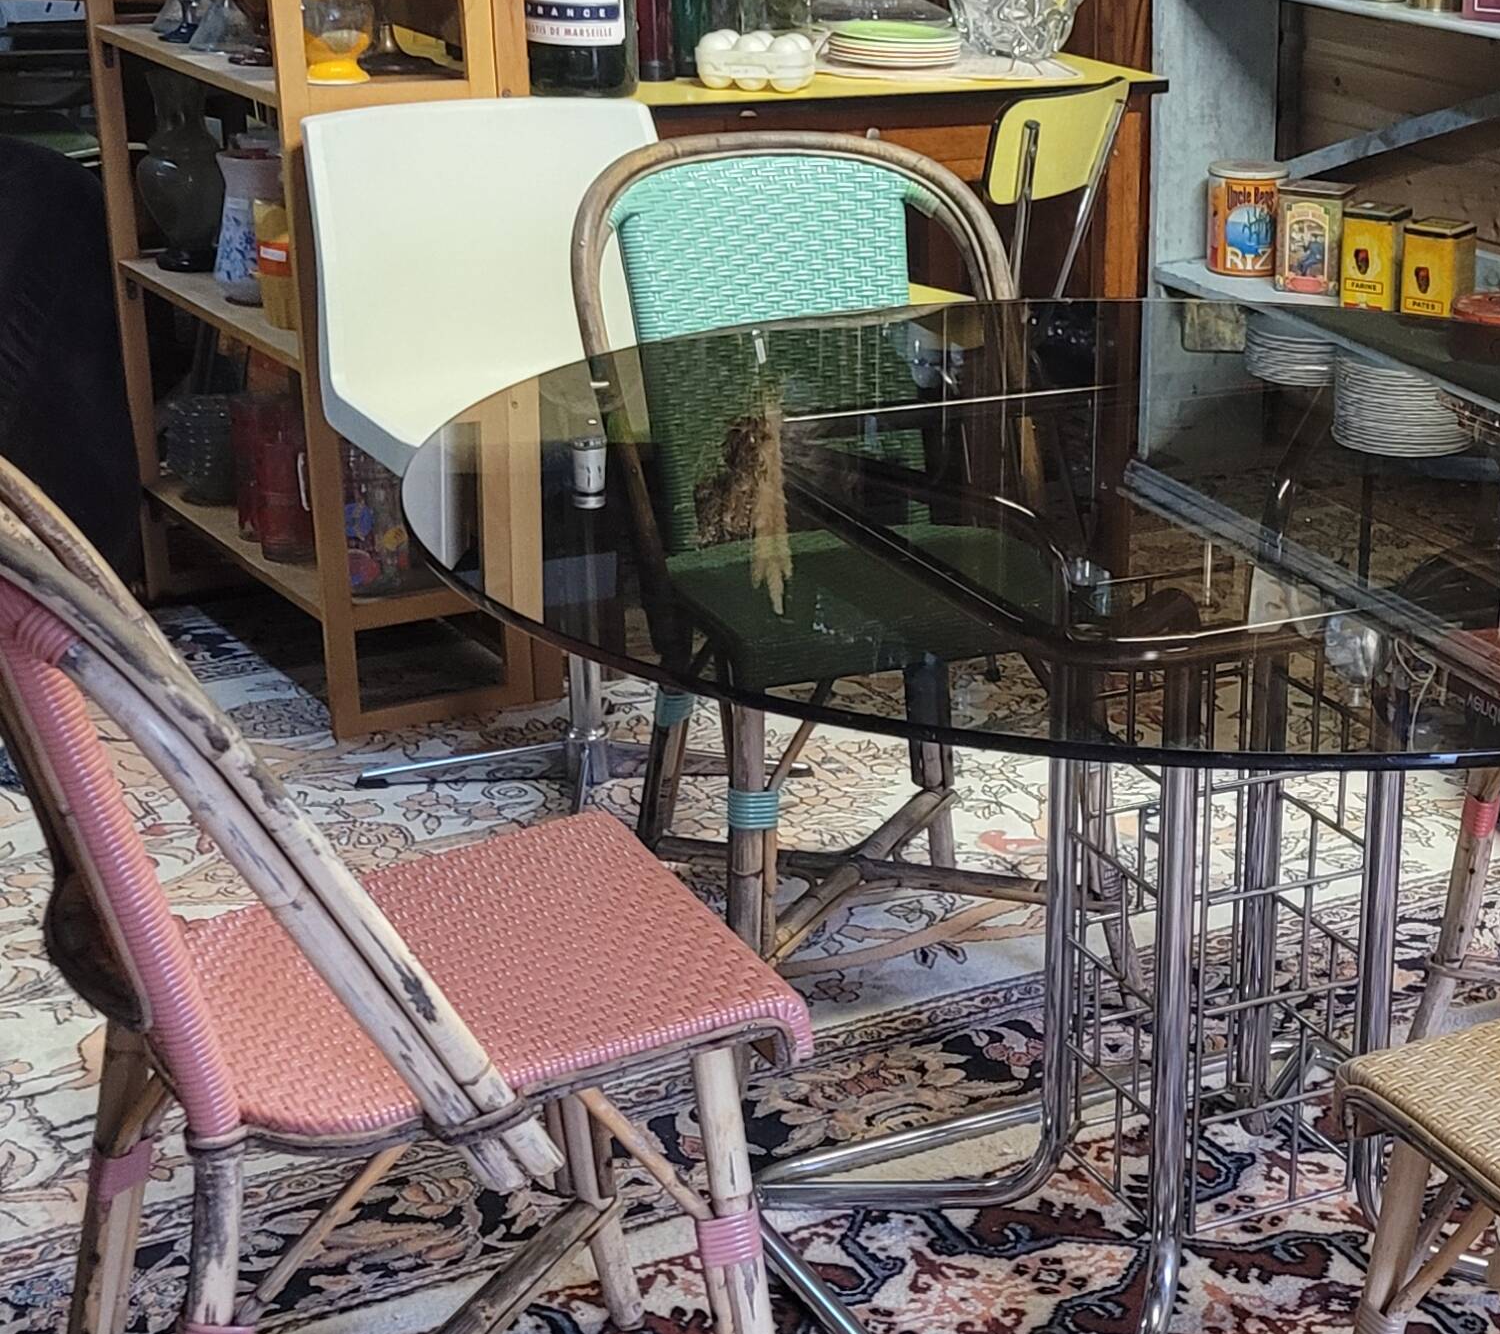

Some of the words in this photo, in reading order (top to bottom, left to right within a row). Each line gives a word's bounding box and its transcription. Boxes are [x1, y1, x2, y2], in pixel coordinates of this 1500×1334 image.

[550, 25, 560, 36] DE
[564, 26, 613, 38] MARSEILLE
[1226, 185, 1252, 210] Uncle
[1226, 247, 1272, 270] RIZ
